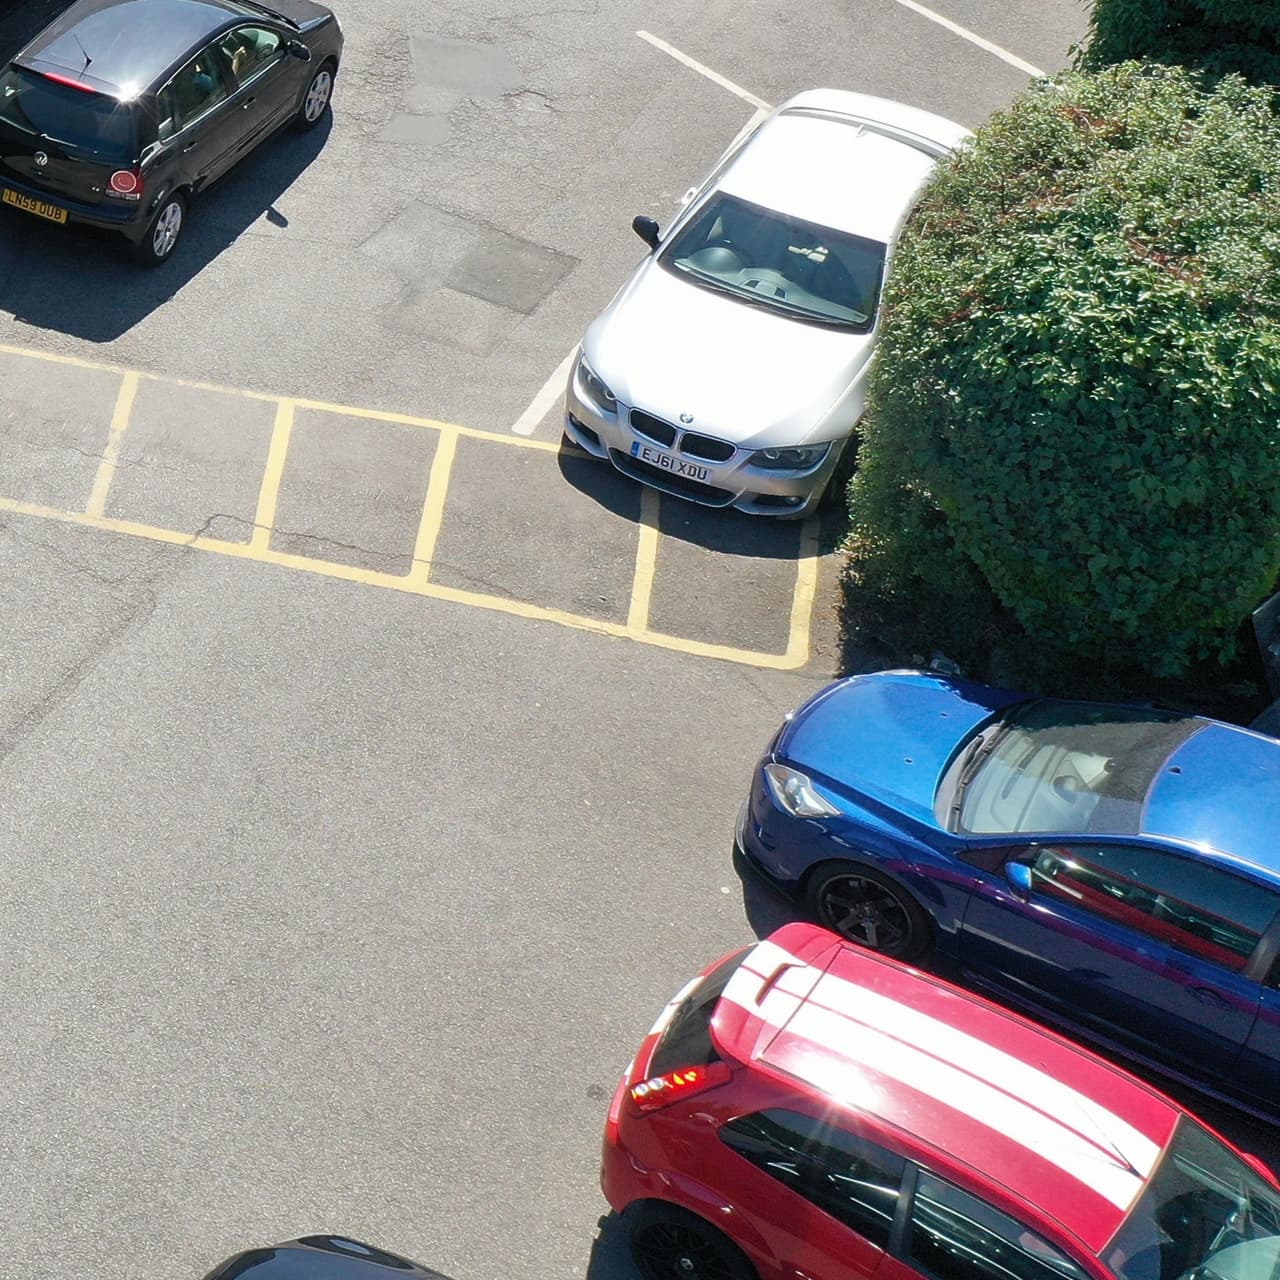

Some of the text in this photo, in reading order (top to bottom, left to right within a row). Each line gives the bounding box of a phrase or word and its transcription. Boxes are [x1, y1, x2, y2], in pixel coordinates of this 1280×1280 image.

[7, 191, 37, 211] LN59
[642, 447, 707, 480] EJ61 XDU
